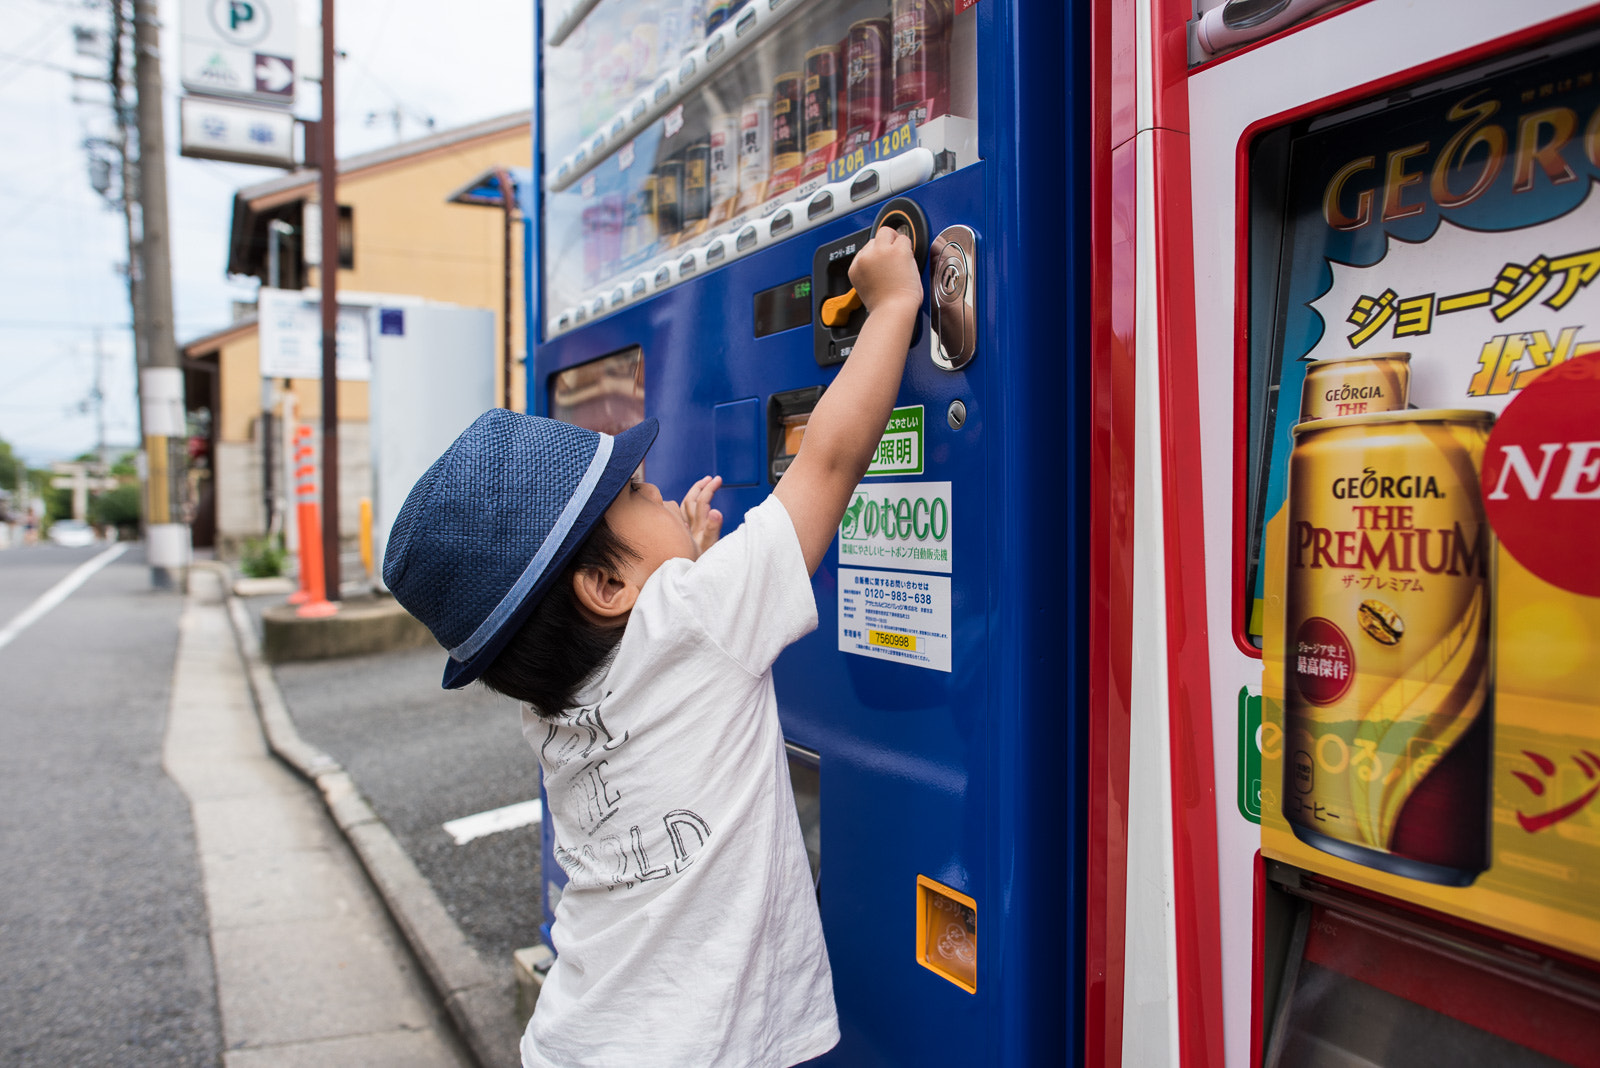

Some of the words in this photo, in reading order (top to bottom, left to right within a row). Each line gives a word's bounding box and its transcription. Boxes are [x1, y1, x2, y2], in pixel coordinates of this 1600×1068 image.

[230, 1, 254, 29] P
[874, 124, 911, 159] 120円
[831, 148, 865, 181] 120円
[1346, 248, 1600, 349] ジョージア
[1325, 383, 1384, 402] GEORGIA
[1336, 402, 1368, 417] THE
[1332, 466, 1446, 500] GEORGIA
[1352, 505, 1414, 532] THE
[1294, 520, 1488, 578] PREMIUM
[864, 587, 932, 605] 0120-983-638
[1341, 574, 1425, 592] ザ・プレミアム
[875, 632, 910, 648] 7560998
[1297, 655, 1349, 681] 最高傑作
